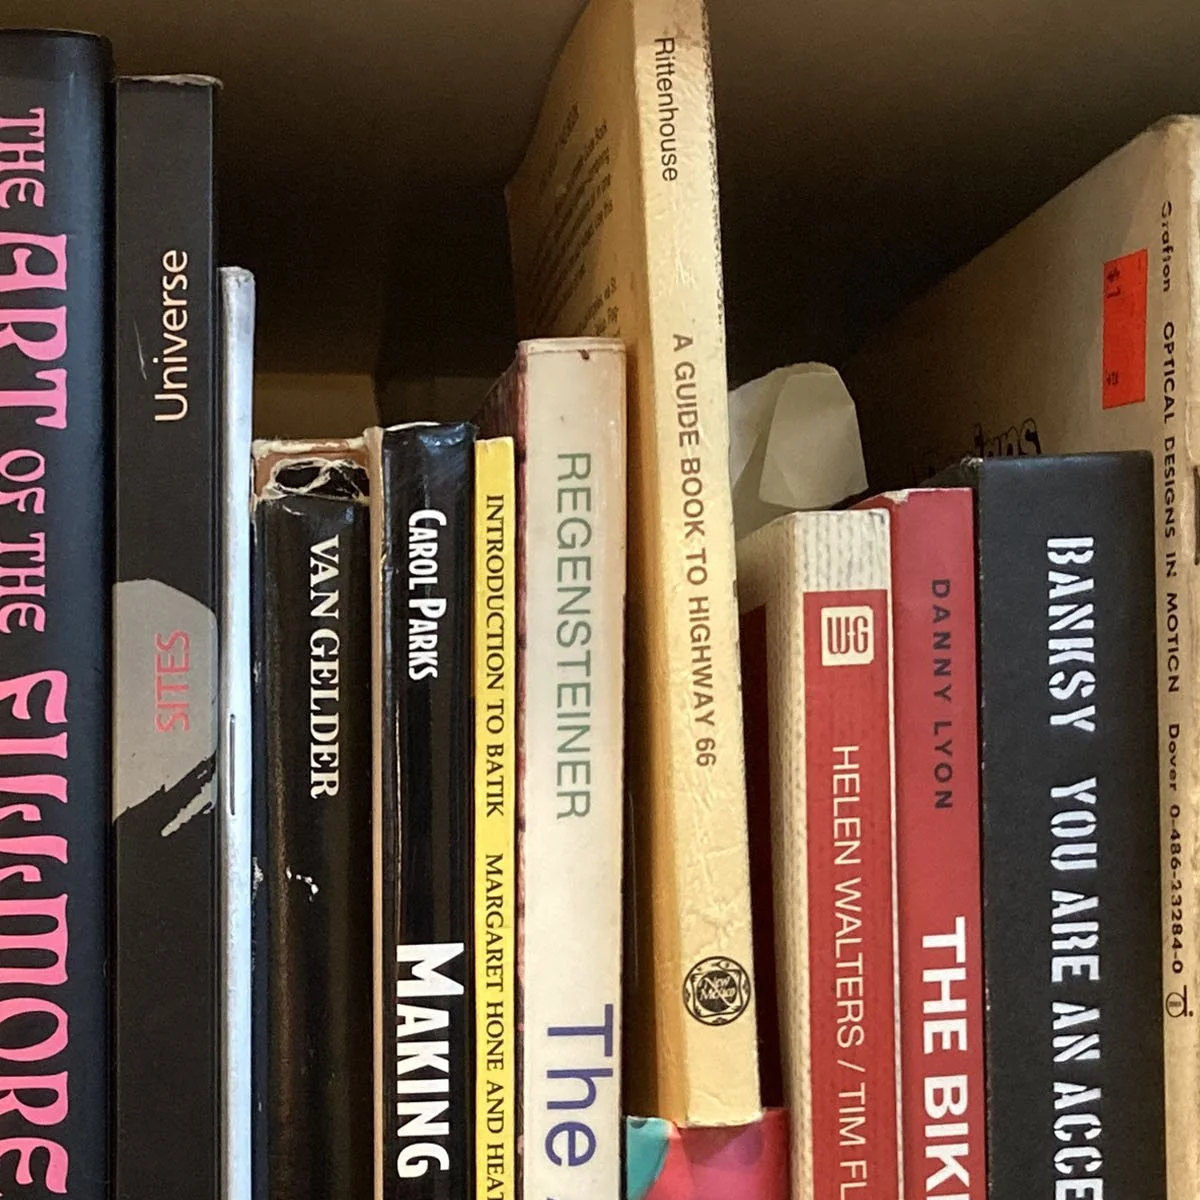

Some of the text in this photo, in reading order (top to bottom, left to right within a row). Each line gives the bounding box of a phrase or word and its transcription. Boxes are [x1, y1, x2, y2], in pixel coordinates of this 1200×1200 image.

[655, 37, 678, 182] Rittenhouse
[155, 249, 188, 422] Universe
[674, 361, 717, 767] GUIDE BOOK TO HIGHWAY 66
[1164, 437, 1176, 538] DESIGNS
[0, 108, 69, 1194] THE ART OF THE FILLMORE
[309, 534, 341, 799] VAN GELDER
[408, 509, 446, 680] CAROL PARKS
[486, 494, 505, 817] INTRODUCTION TO BATIK
[556, 453, 592, 820] REGENSTEINER
[1047, 536, 1096, 732] BANKSY
[155, 630, 190, 732] SITES
[930, 579, 954, 810] DANNY LYON
[832, 745, 862, 865] HELEN
[1050, 777, 1098, 870] YOU
[1168, 724, 1183, 974] Dover 0-486-23284-0
[486, 854, 506, 992] MARGARET
[834, 877, 865, 1048] WALTERS
[923, 917, 968, 1052] THE
[1051, 889, 1101, 983] ARE
[397, 943, 464, 1177] MAKING
[486, 1000, 506, 1072] HONE
[486, 1081, 506, 1135] AND
[546, 1004, 613, 1167] The
[838, 1083, 867, 1147] TIM
